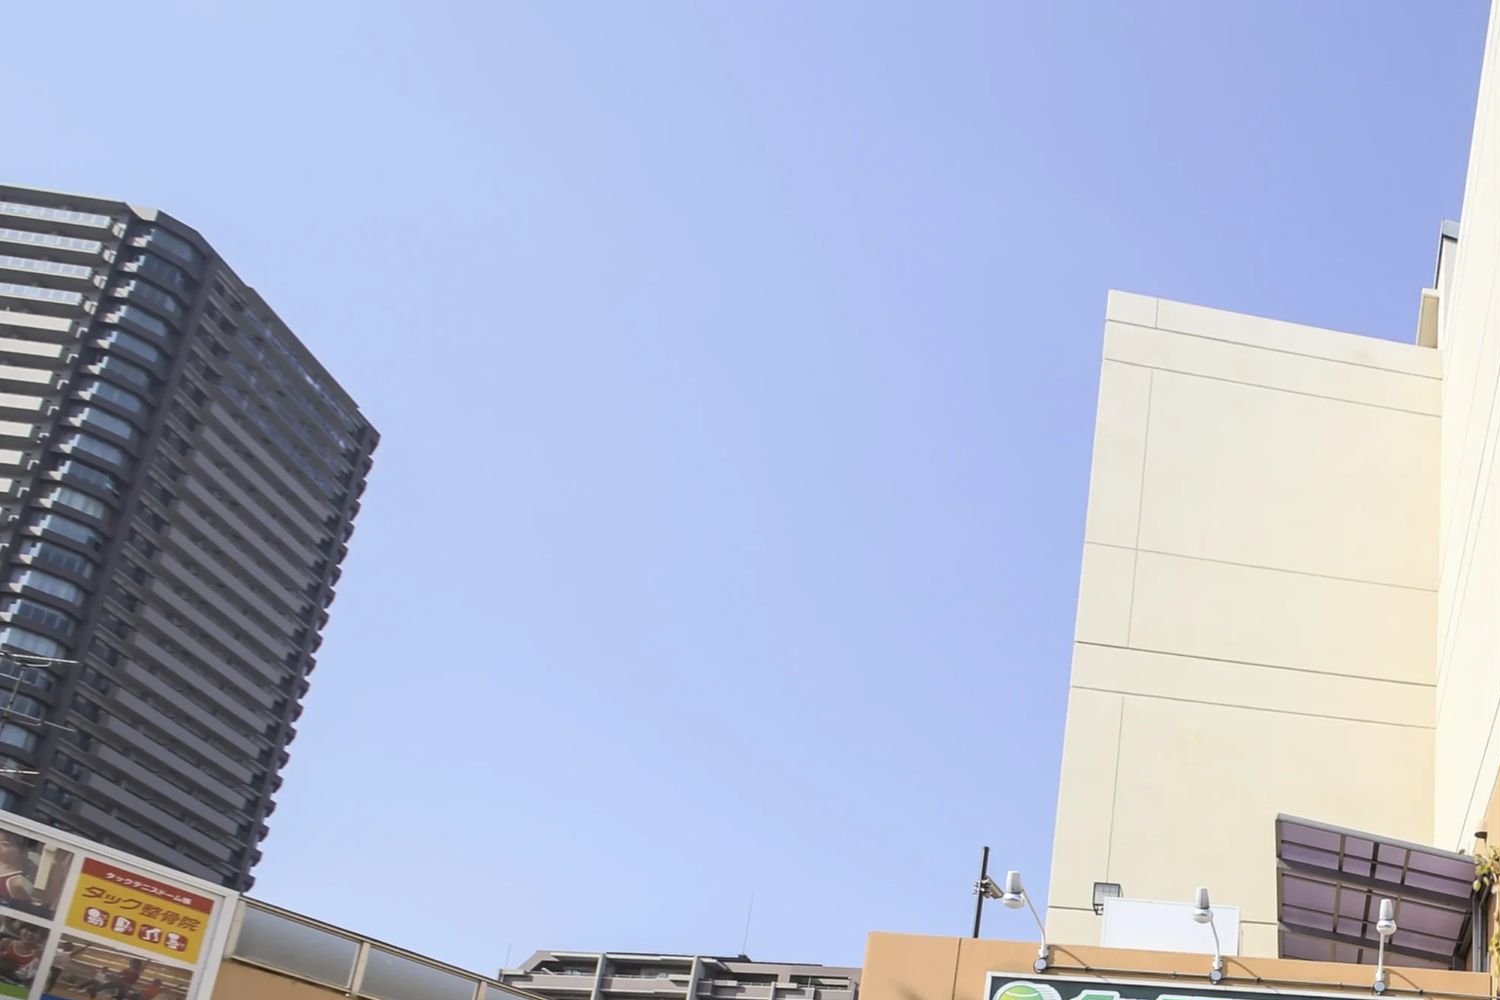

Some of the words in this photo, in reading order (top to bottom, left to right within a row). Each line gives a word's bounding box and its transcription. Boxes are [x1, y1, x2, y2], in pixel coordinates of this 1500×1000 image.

[82, 886, 202, 932] タック整骨院
